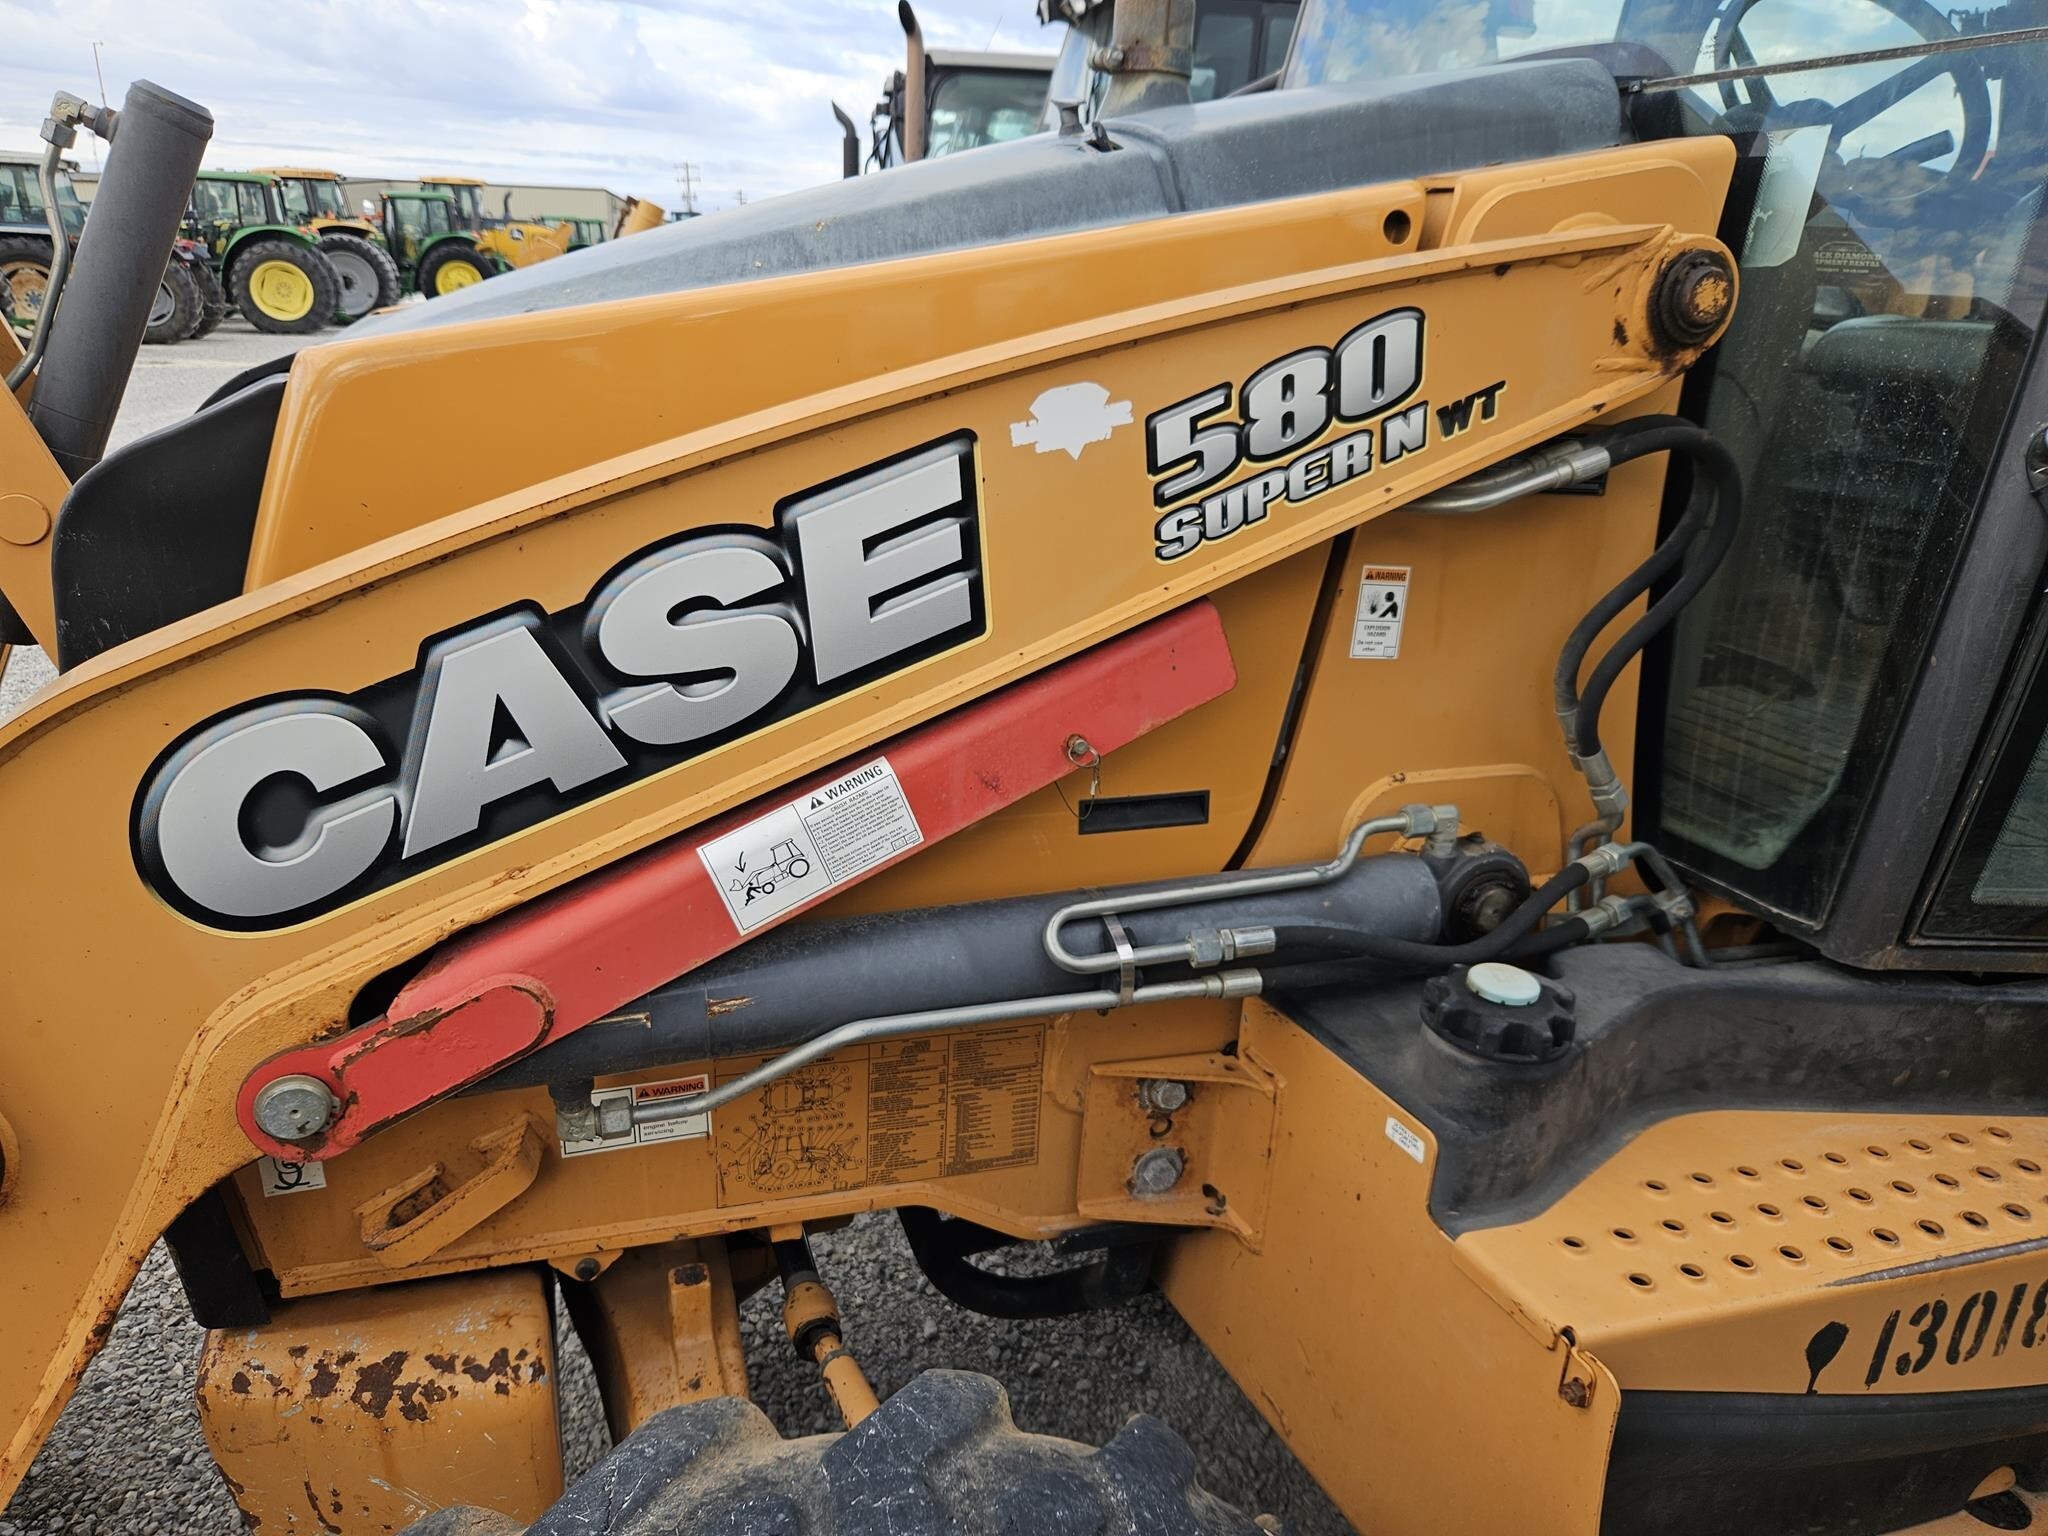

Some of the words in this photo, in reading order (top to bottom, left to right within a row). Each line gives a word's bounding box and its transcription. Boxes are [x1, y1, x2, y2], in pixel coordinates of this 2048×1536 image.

[1147, 308, 1423, 506] 580
[1155, 430, 1373, 560] SUPER
[1381, 401, 1428, 463] N
[1437, 381, 1506, 437] WT
[1375, 571, 1406, 581] WARNING
[140, 438, 972, 917] CASE
[825, 765, 883, 800] WARNING
[653, 1081, 704, 1096] WARNING
[643, 1121, 665, 1131] engine
